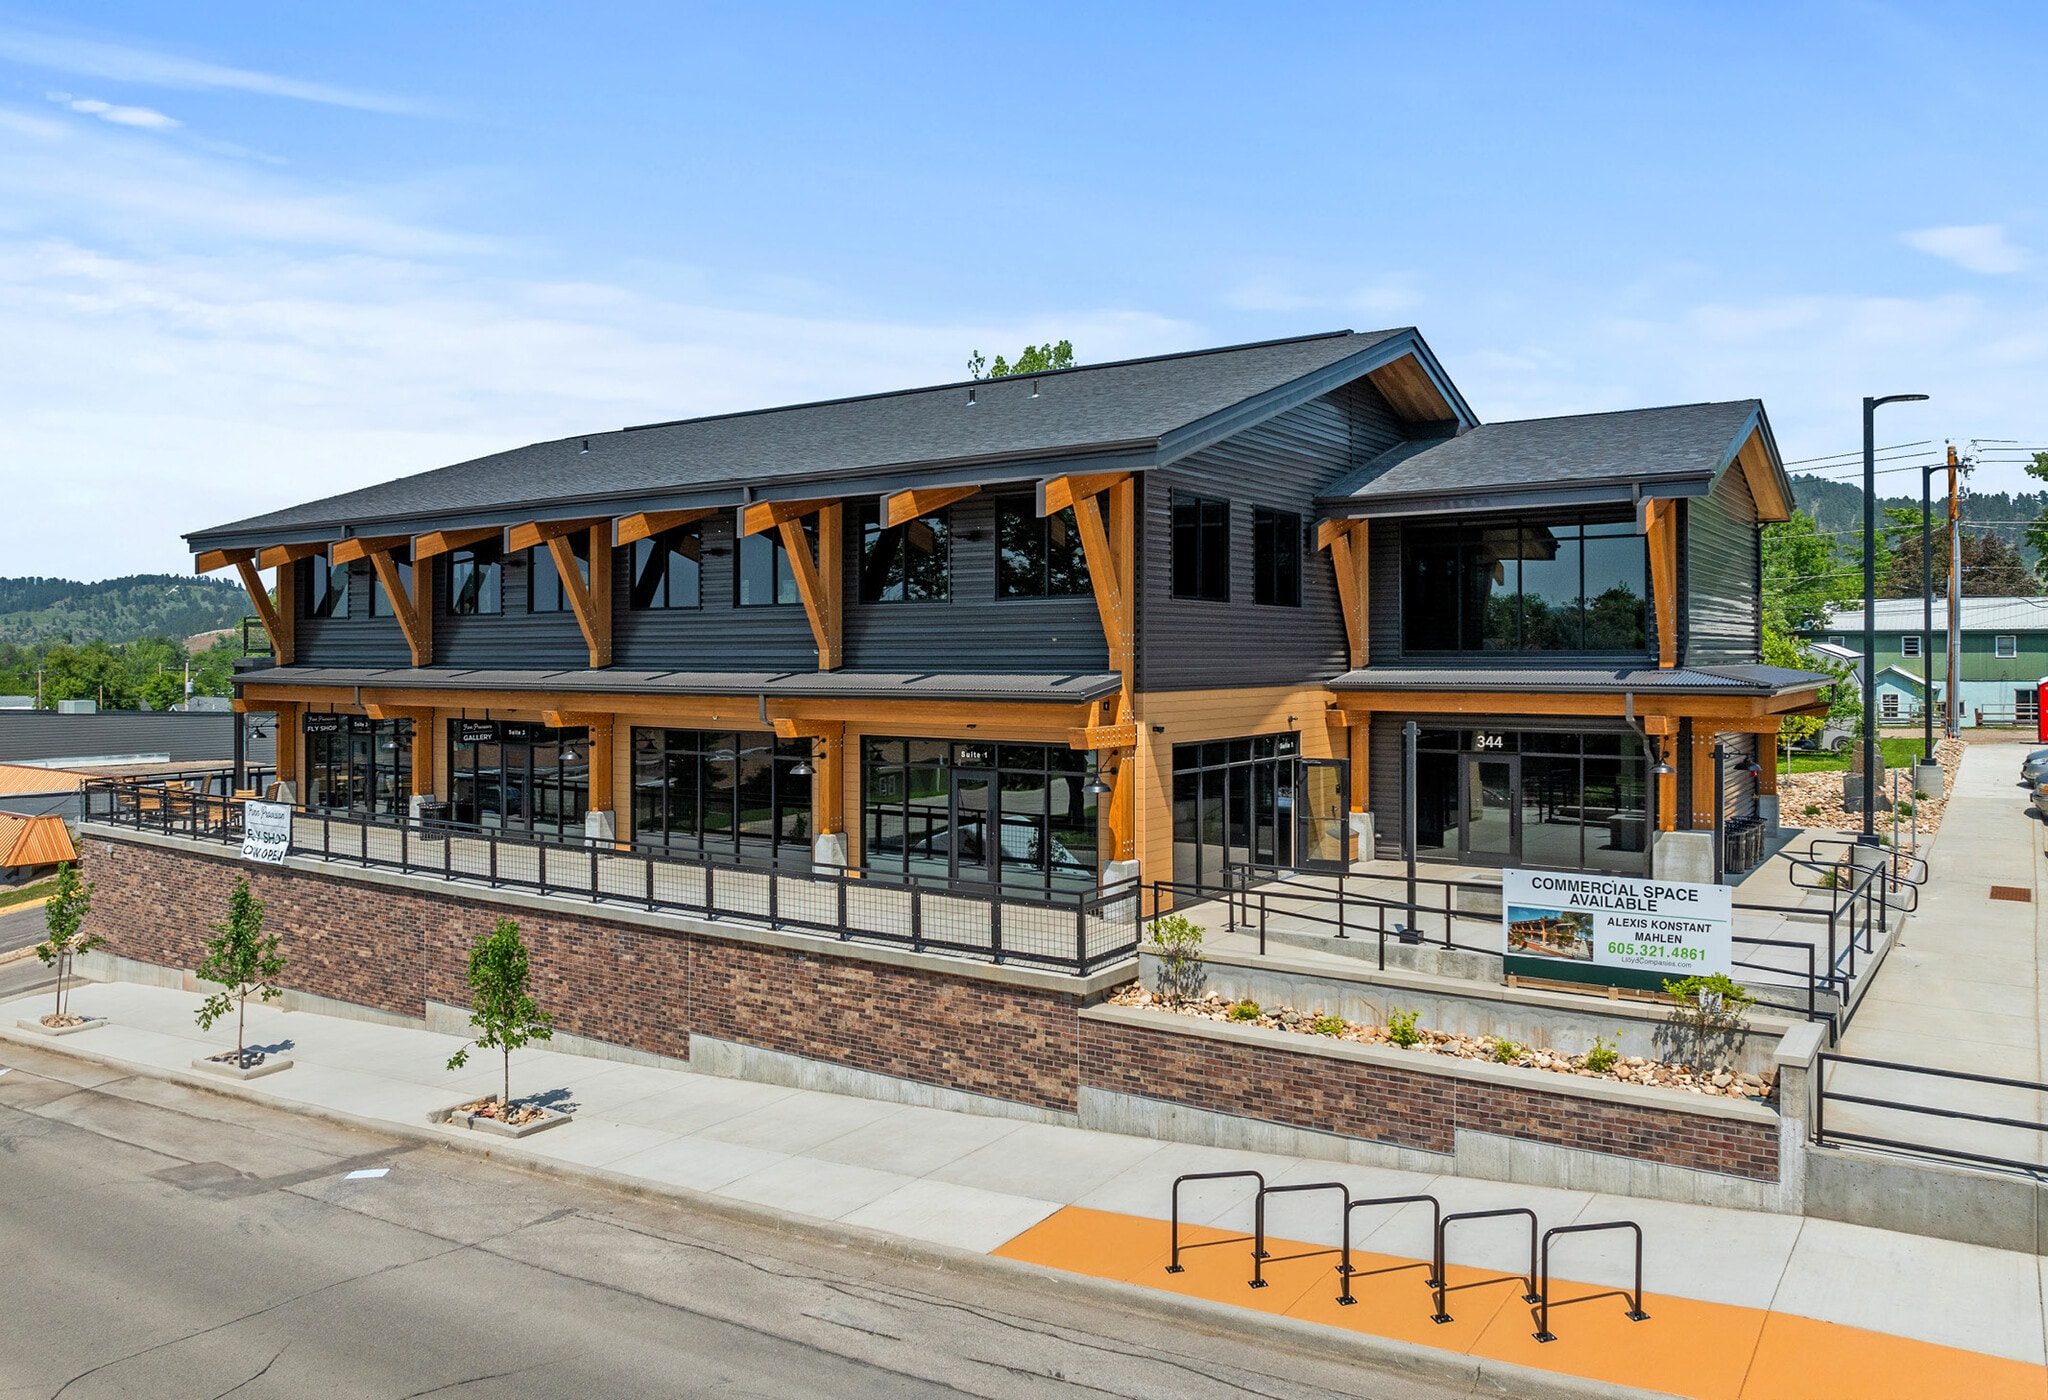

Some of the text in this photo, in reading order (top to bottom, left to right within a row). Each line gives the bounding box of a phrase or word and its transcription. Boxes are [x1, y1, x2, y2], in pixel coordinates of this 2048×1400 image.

[463, 733, 493, 741] GALLERY
[1477, 735, 1503, 748] 344
[961, 750, 981, 758] Suite
[261, 849, 284, 862] OPEN
[1532, 877, 1699, 902] COMMERCIAL SPACE
[1569, 893, 1658, 912] AVAILABLE
[1607, 917, 1712, 933] ALEXIS KONSTANT
[1635, 932, 1682, 944] MAHLEN
[1608, 941, 1705, 961] 605.321.4861
[1621, 956, 1692, 968] LloydCompanies.com
